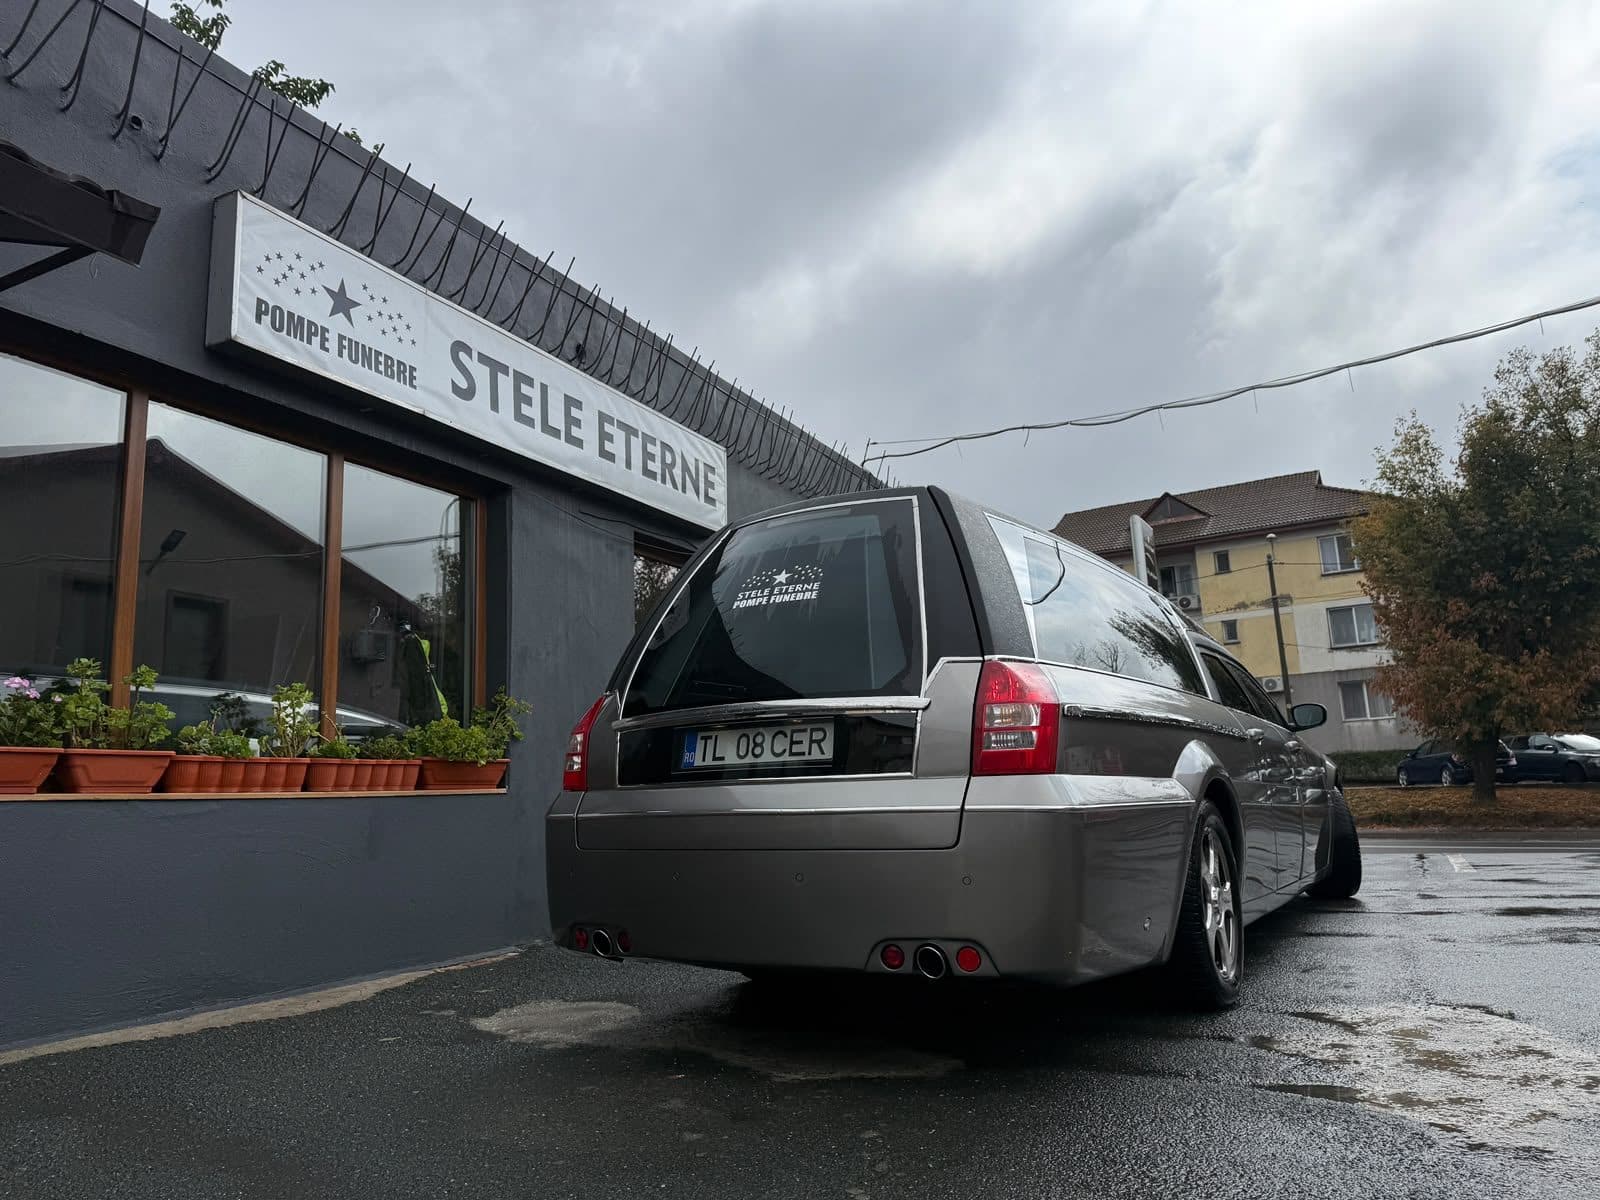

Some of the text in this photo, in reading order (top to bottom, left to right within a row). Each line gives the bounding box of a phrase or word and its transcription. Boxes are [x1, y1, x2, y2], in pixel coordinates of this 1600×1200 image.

[255, 297, 418, 391] POMPE FUNEBRE
[450, 339, 718, 508] STELE ETERNE
[732, 591, 819, 609] POMPE FUNEBRE
[737, 582, 821, 600] STELE ETERNE
[700, 727, 828, 763] TL 08 CER
